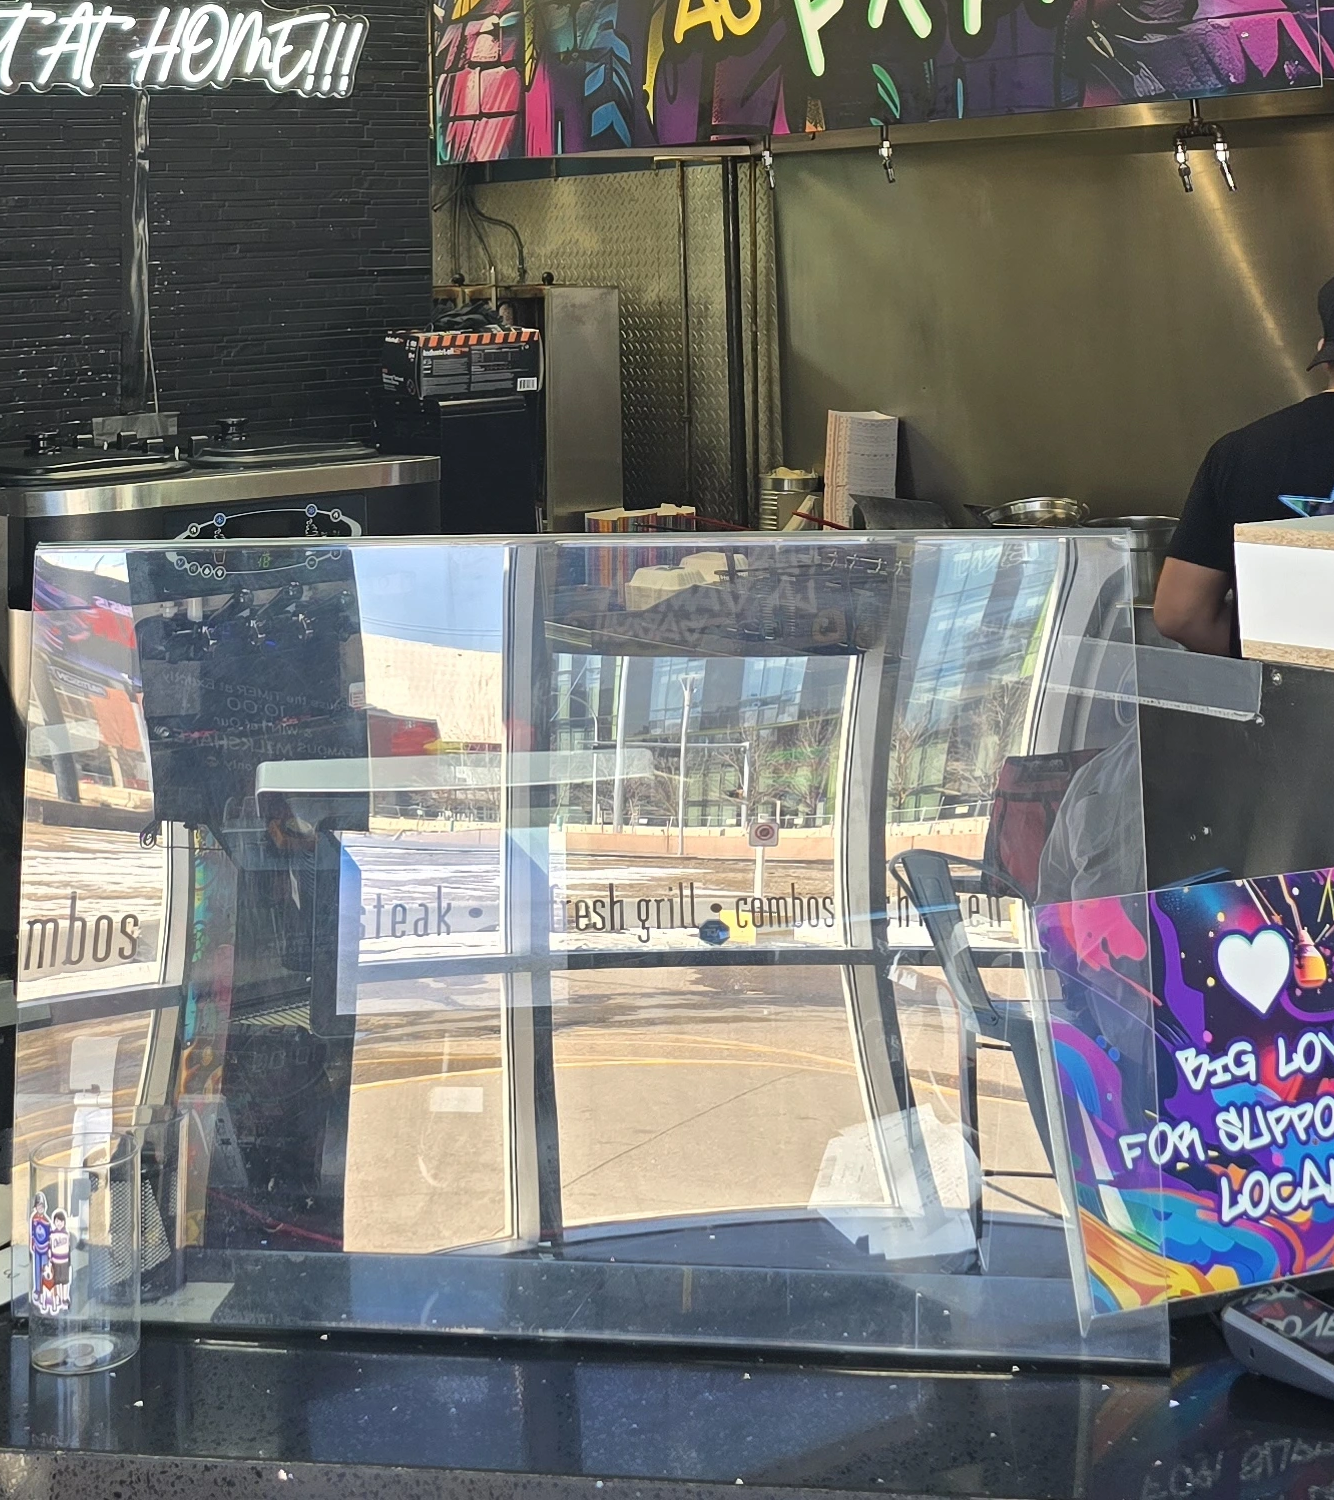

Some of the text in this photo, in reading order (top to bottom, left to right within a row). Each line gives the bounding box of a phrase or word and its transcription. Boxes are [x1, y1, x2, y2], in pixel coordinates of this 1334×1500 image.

[636, 881, 696, 943] grill
[735, 882, 835, 929] combos
[1175, 1040, 1257, 1091] BIG
[1118, 1120, 1205, 1170] FOR
